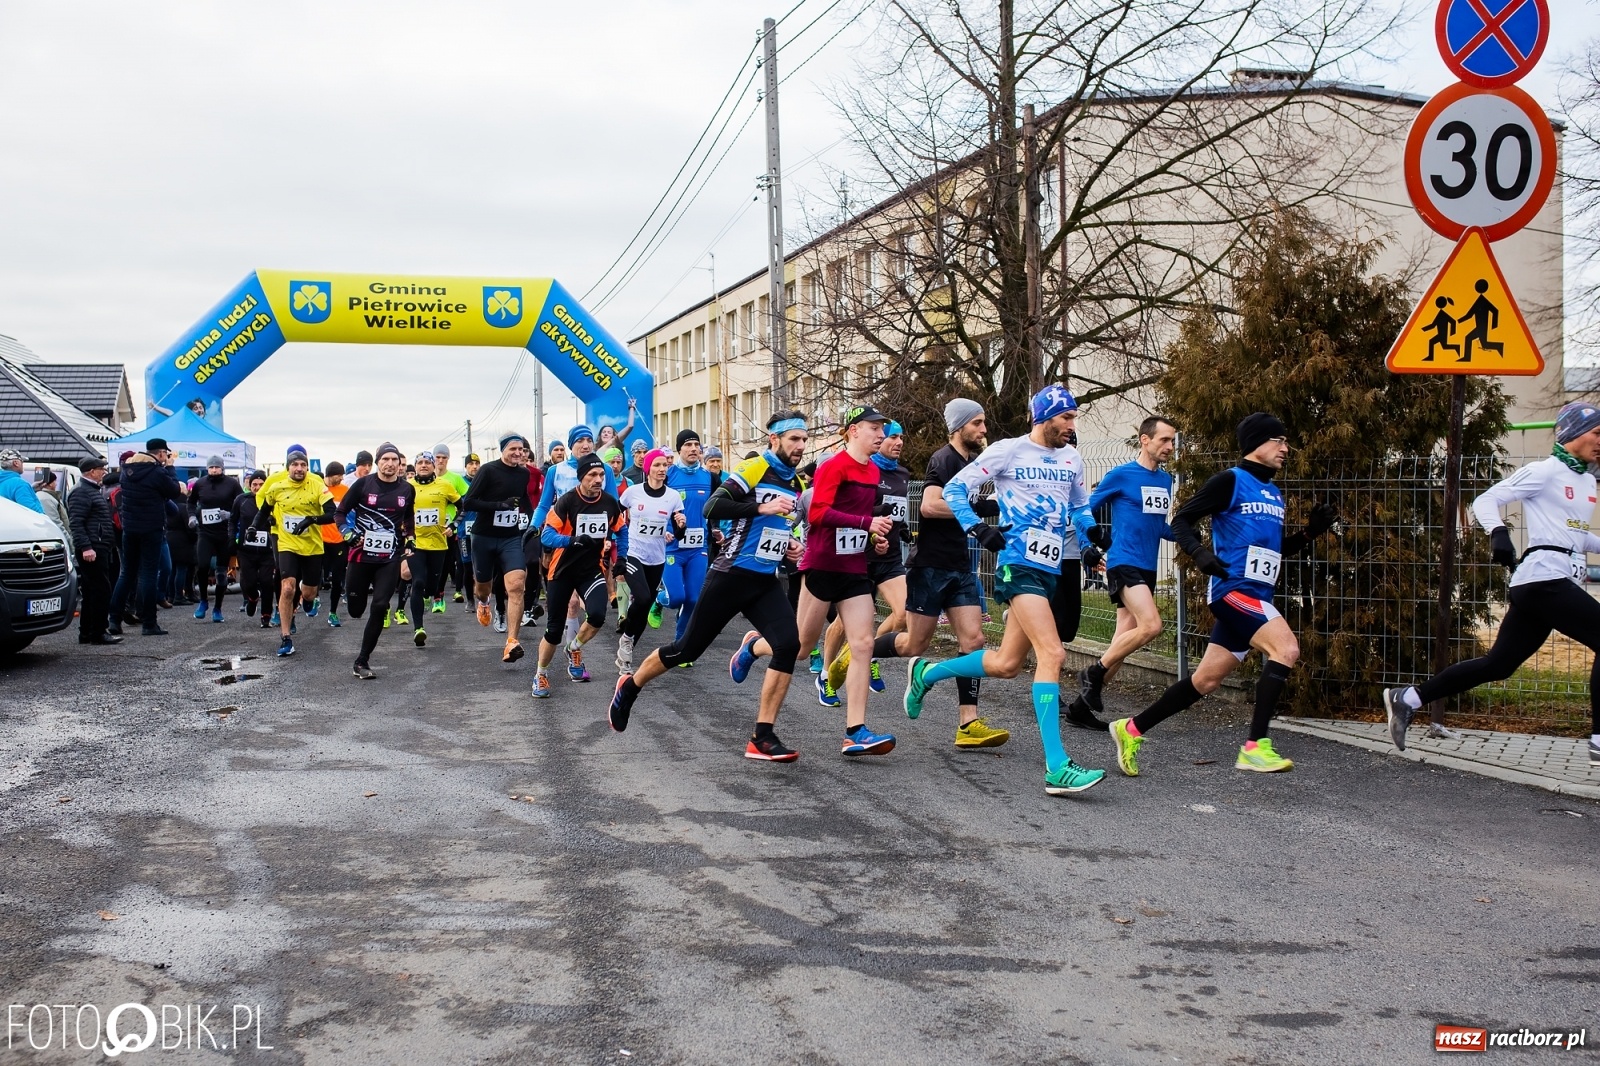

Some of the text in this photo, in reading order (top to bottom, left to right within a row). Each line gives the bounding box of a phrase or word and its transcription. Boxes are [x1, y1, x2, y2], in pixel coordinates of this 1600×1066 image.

[1430, 120, 1533, 201] 30
[368, 282, 447, 296] Gmina
[348, 297, 468, 313] Pietrowice
[363, 315, 452, 330] Wielkie
[174, 293, 258, 370] Gmina ludzi
[194, 312, 272, 384] aktywnych
[553, 304, 630, 378] Gmina ludzi
[540, 321, 613, 391] aktywnych
[1145, 496, 1169, 509] 458
[891, 505, 906, 517] 36
[285, 521, 298, 530] 13
[416, 514, 438, 524] 112
[496, 513, 518, 524] 113
[579, 522, 606, 534] 164
[639, 524, 665, 536] 271
[365, 538, 391, 549] 326
[682, 535, 703, 545] 152
[760, 539, 787, 555] 448
[839, 535, 867, 549] 117
[1028, 540, 1060, 562] 449
[1250, 558, 1278, 579] 131
[31, 598, 60, 613] SRC 7YF4
